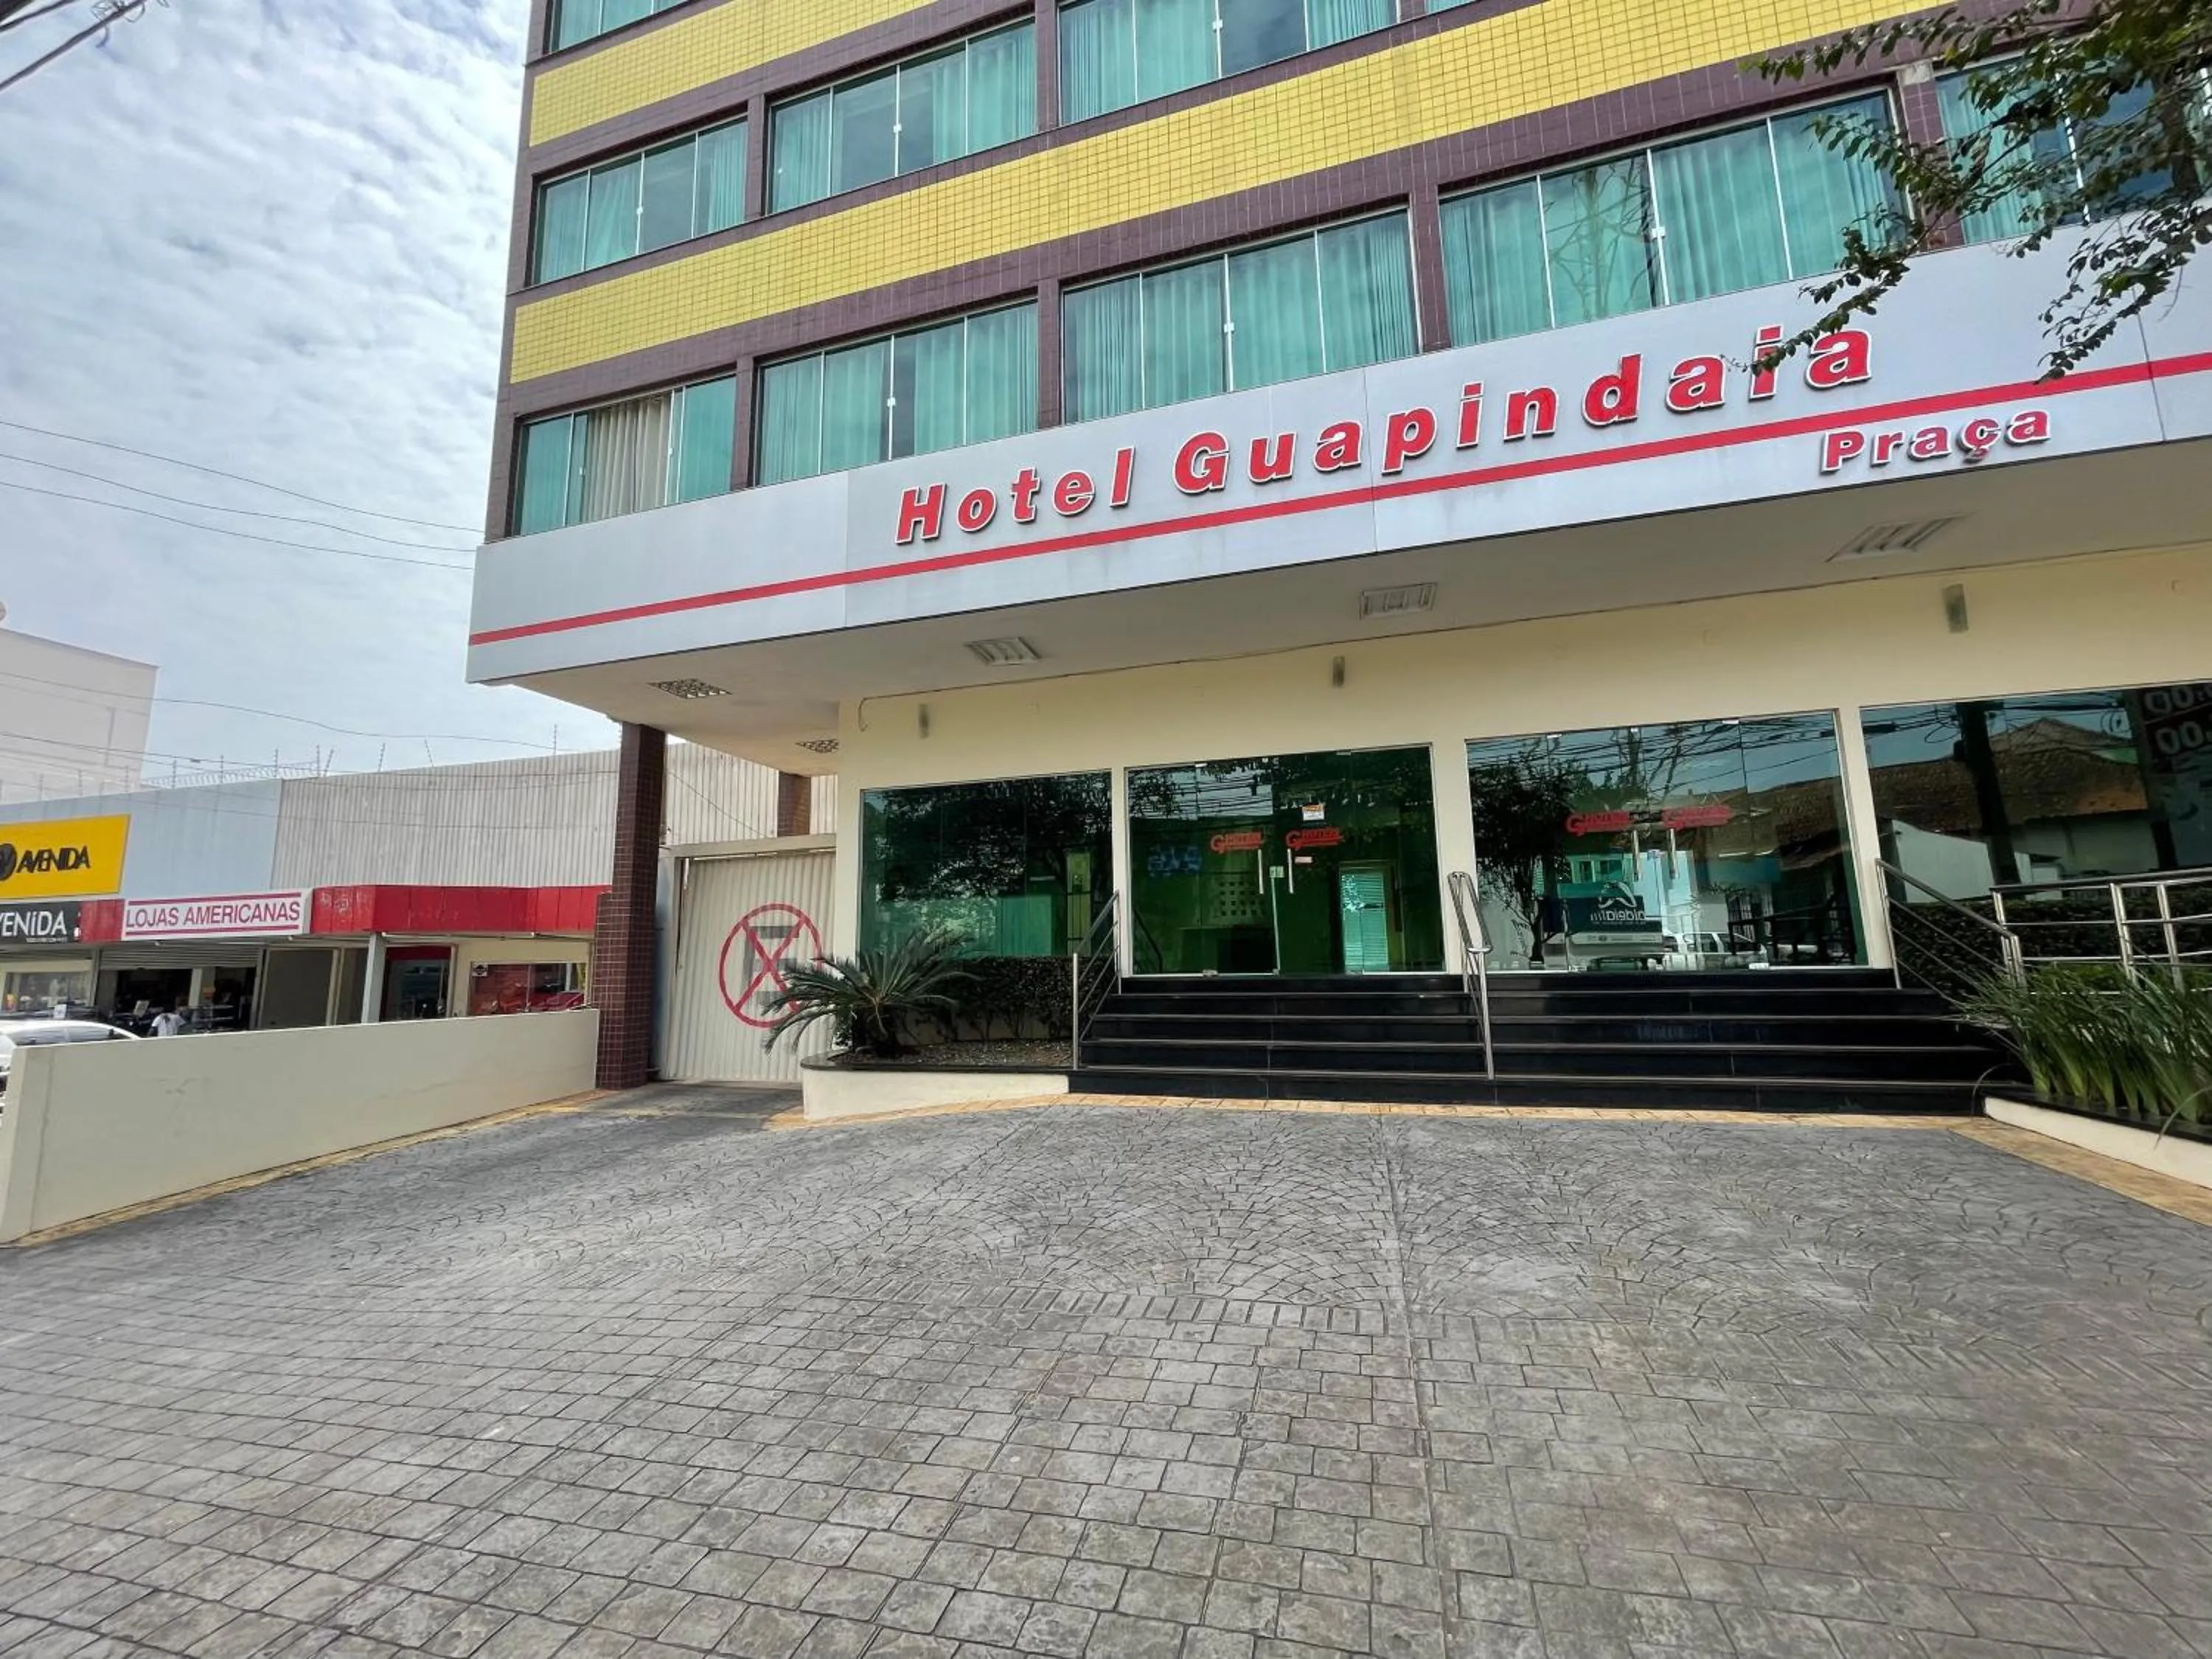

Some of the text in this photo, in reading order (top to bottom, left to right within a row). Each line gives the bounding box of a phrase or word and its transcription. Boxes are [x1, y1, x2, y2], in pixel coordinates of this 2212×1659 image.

[895, 324, 1873, 545] Hotel Guapindaia
[1820, 409, 2051, 473] Praça
[16, 846, 91, 874] AVENIDA
[125, 900, 301, 928] LOJAS AMERICANAS
